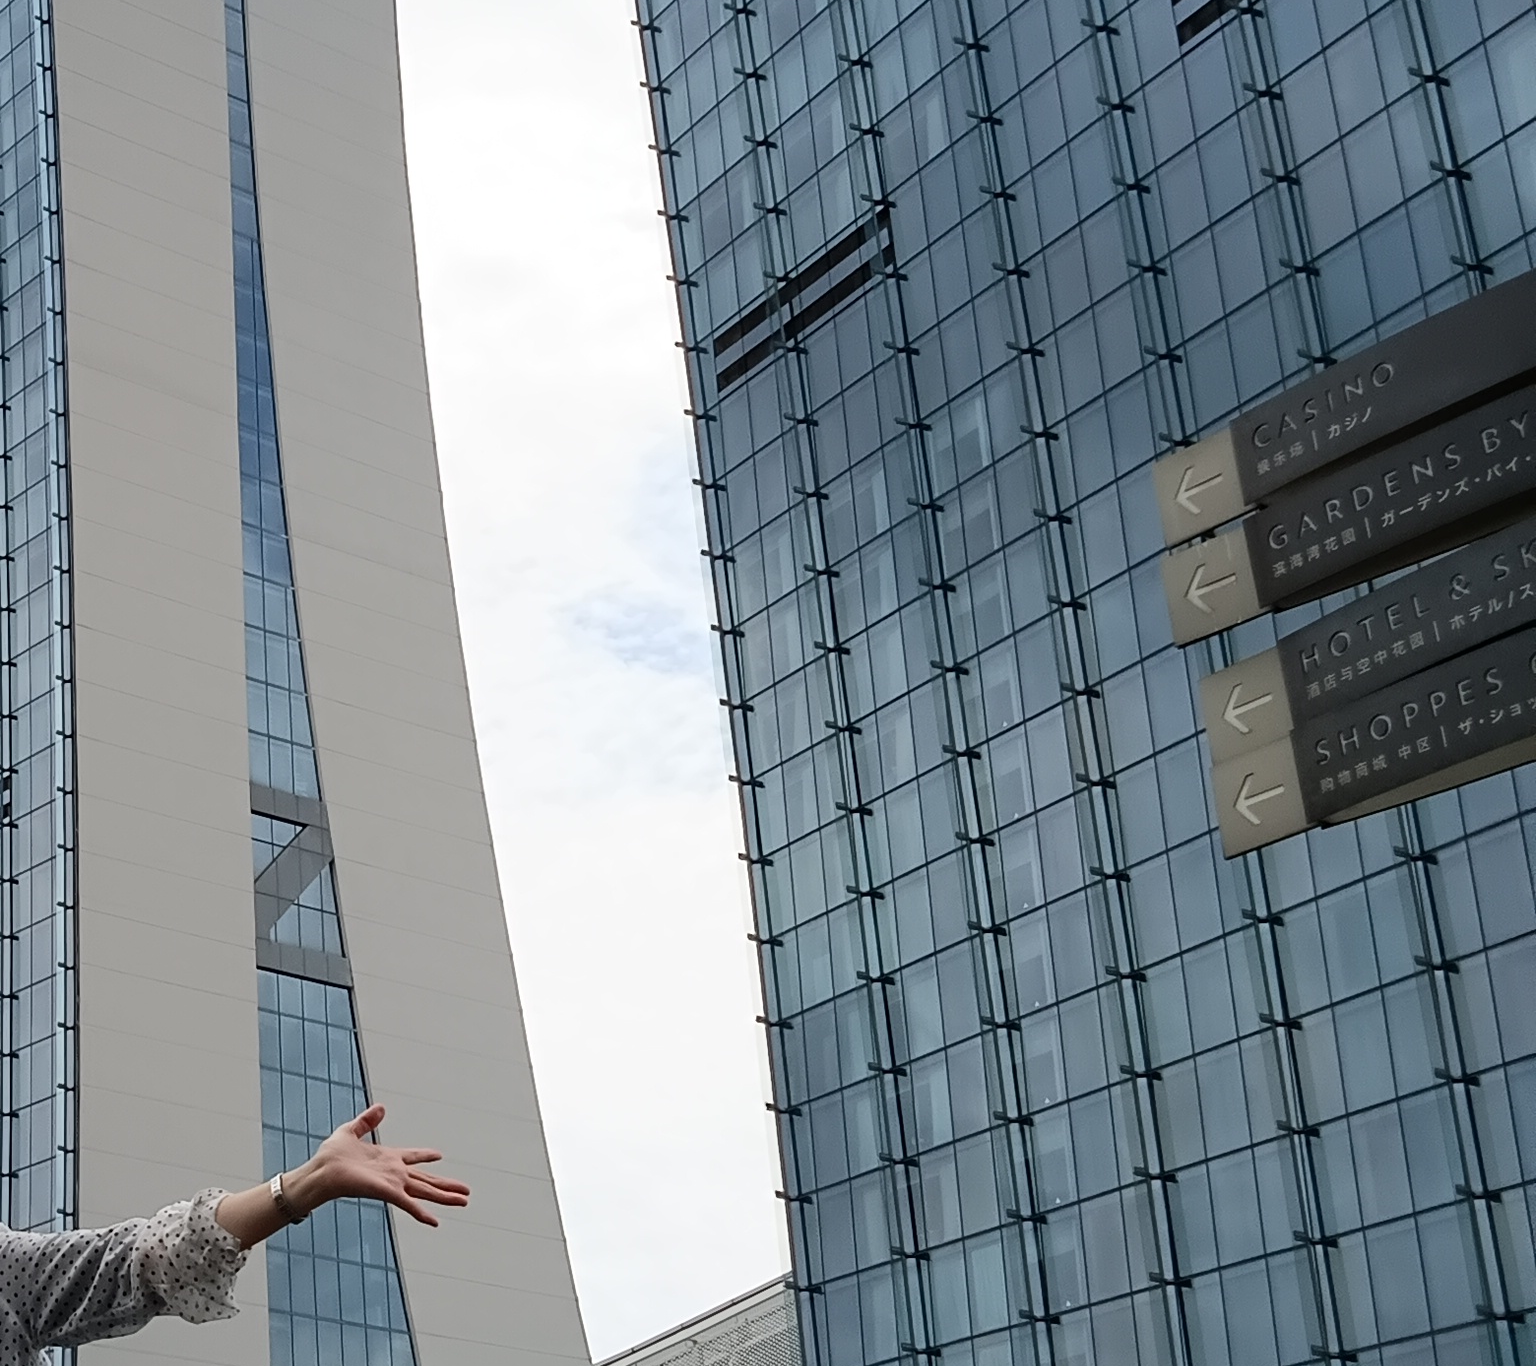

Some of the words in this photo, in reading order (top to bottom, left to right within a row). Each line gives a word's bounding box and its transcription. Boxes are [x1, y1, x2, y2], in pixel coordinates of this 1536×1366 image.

[1251, 362, 1394, 448] CASINO
[1328, 406, 1372, 440] カジノ
[1267, 443, 1461, 550] GARDENS
[1479, 409, 1529, 454] BY
[1299, 594, 1431, 674] HOTEL
[1449, 572, 1471, 601] &
[1306, 631, 1425, 701] 酒店与空中花园
[1315, 665, 1504, 766] SHOPPES
